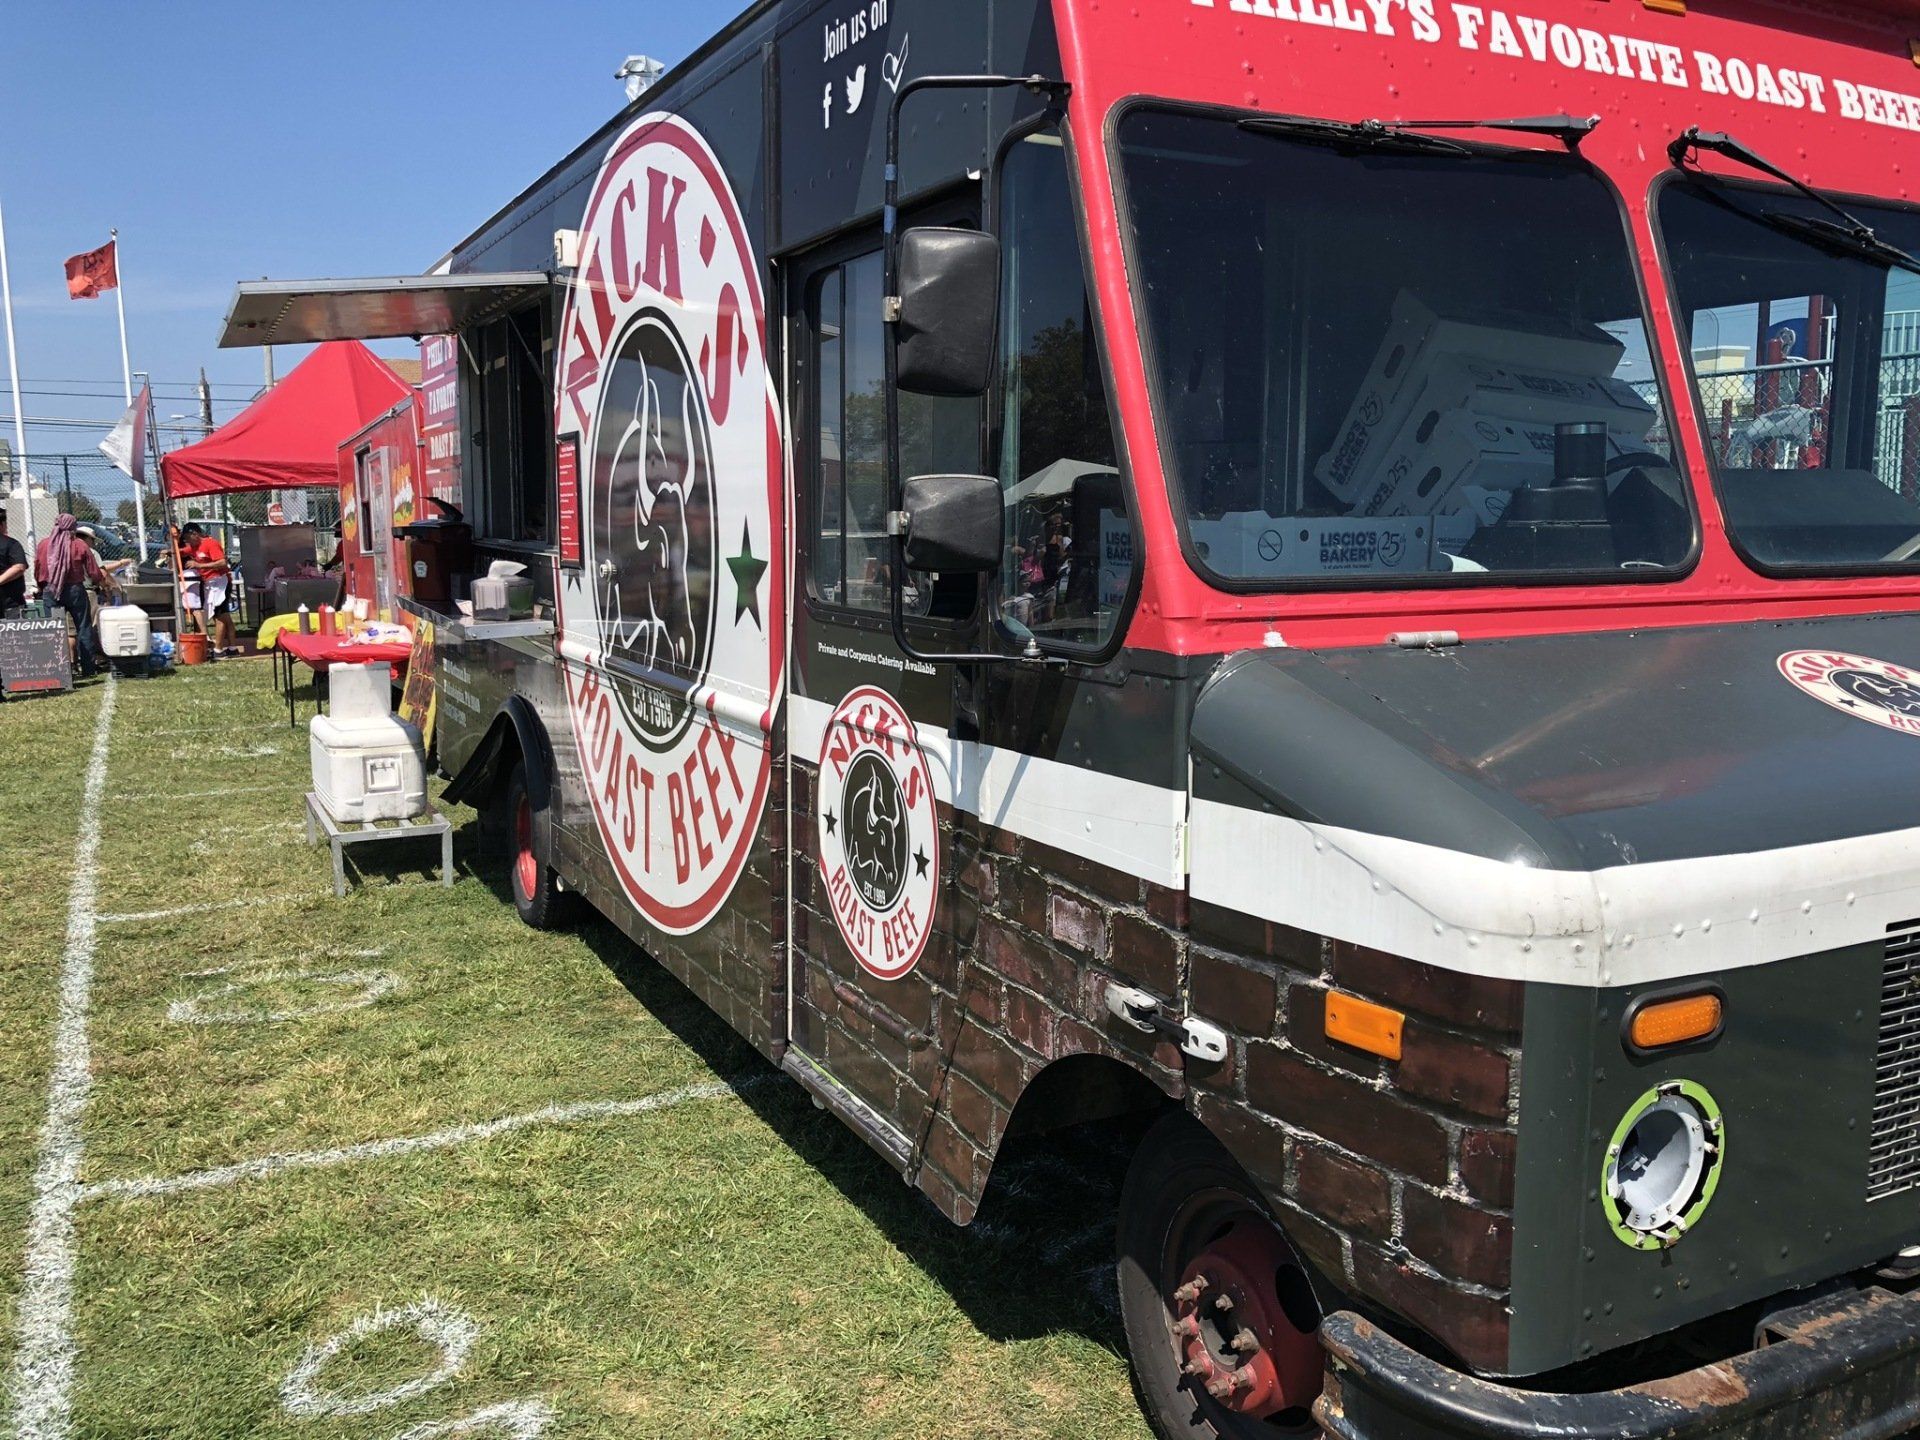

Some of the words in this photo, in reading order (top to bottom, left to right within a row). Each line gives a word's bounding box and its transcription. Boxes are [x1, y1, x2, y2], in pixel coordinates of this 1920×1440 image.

[823, 18, 847, 63] Join
[851, 9, 867, 45] us
[871, 0, 888, 31] on
[1452, 3, 1689, 89] FAVORITE
[1694, 50, 1827, 113] ROAST
[566, 166, 749, 445] NICK'S
[1319, 531, 1376, 547] LISCIO'S
[1319, 548, 1375, 563] BAKERY
[818, 642, 837, 655] Private
[838, 648, 848, 657] and
[849, 649, 877, 663] Corporate
[877, 654, 904, 672] Catering
[904, 659, 937, 676] Available
[1792, 655, 1909, 687] NICK'S
[578, 652, 654, 874] ROAST
[667, 692, 744, 886] BEEF
[828, 703, 925, 810] NICK'S
[831, 863, 876, 956] ROAST
[881, 896, 919, 962] BEEF
